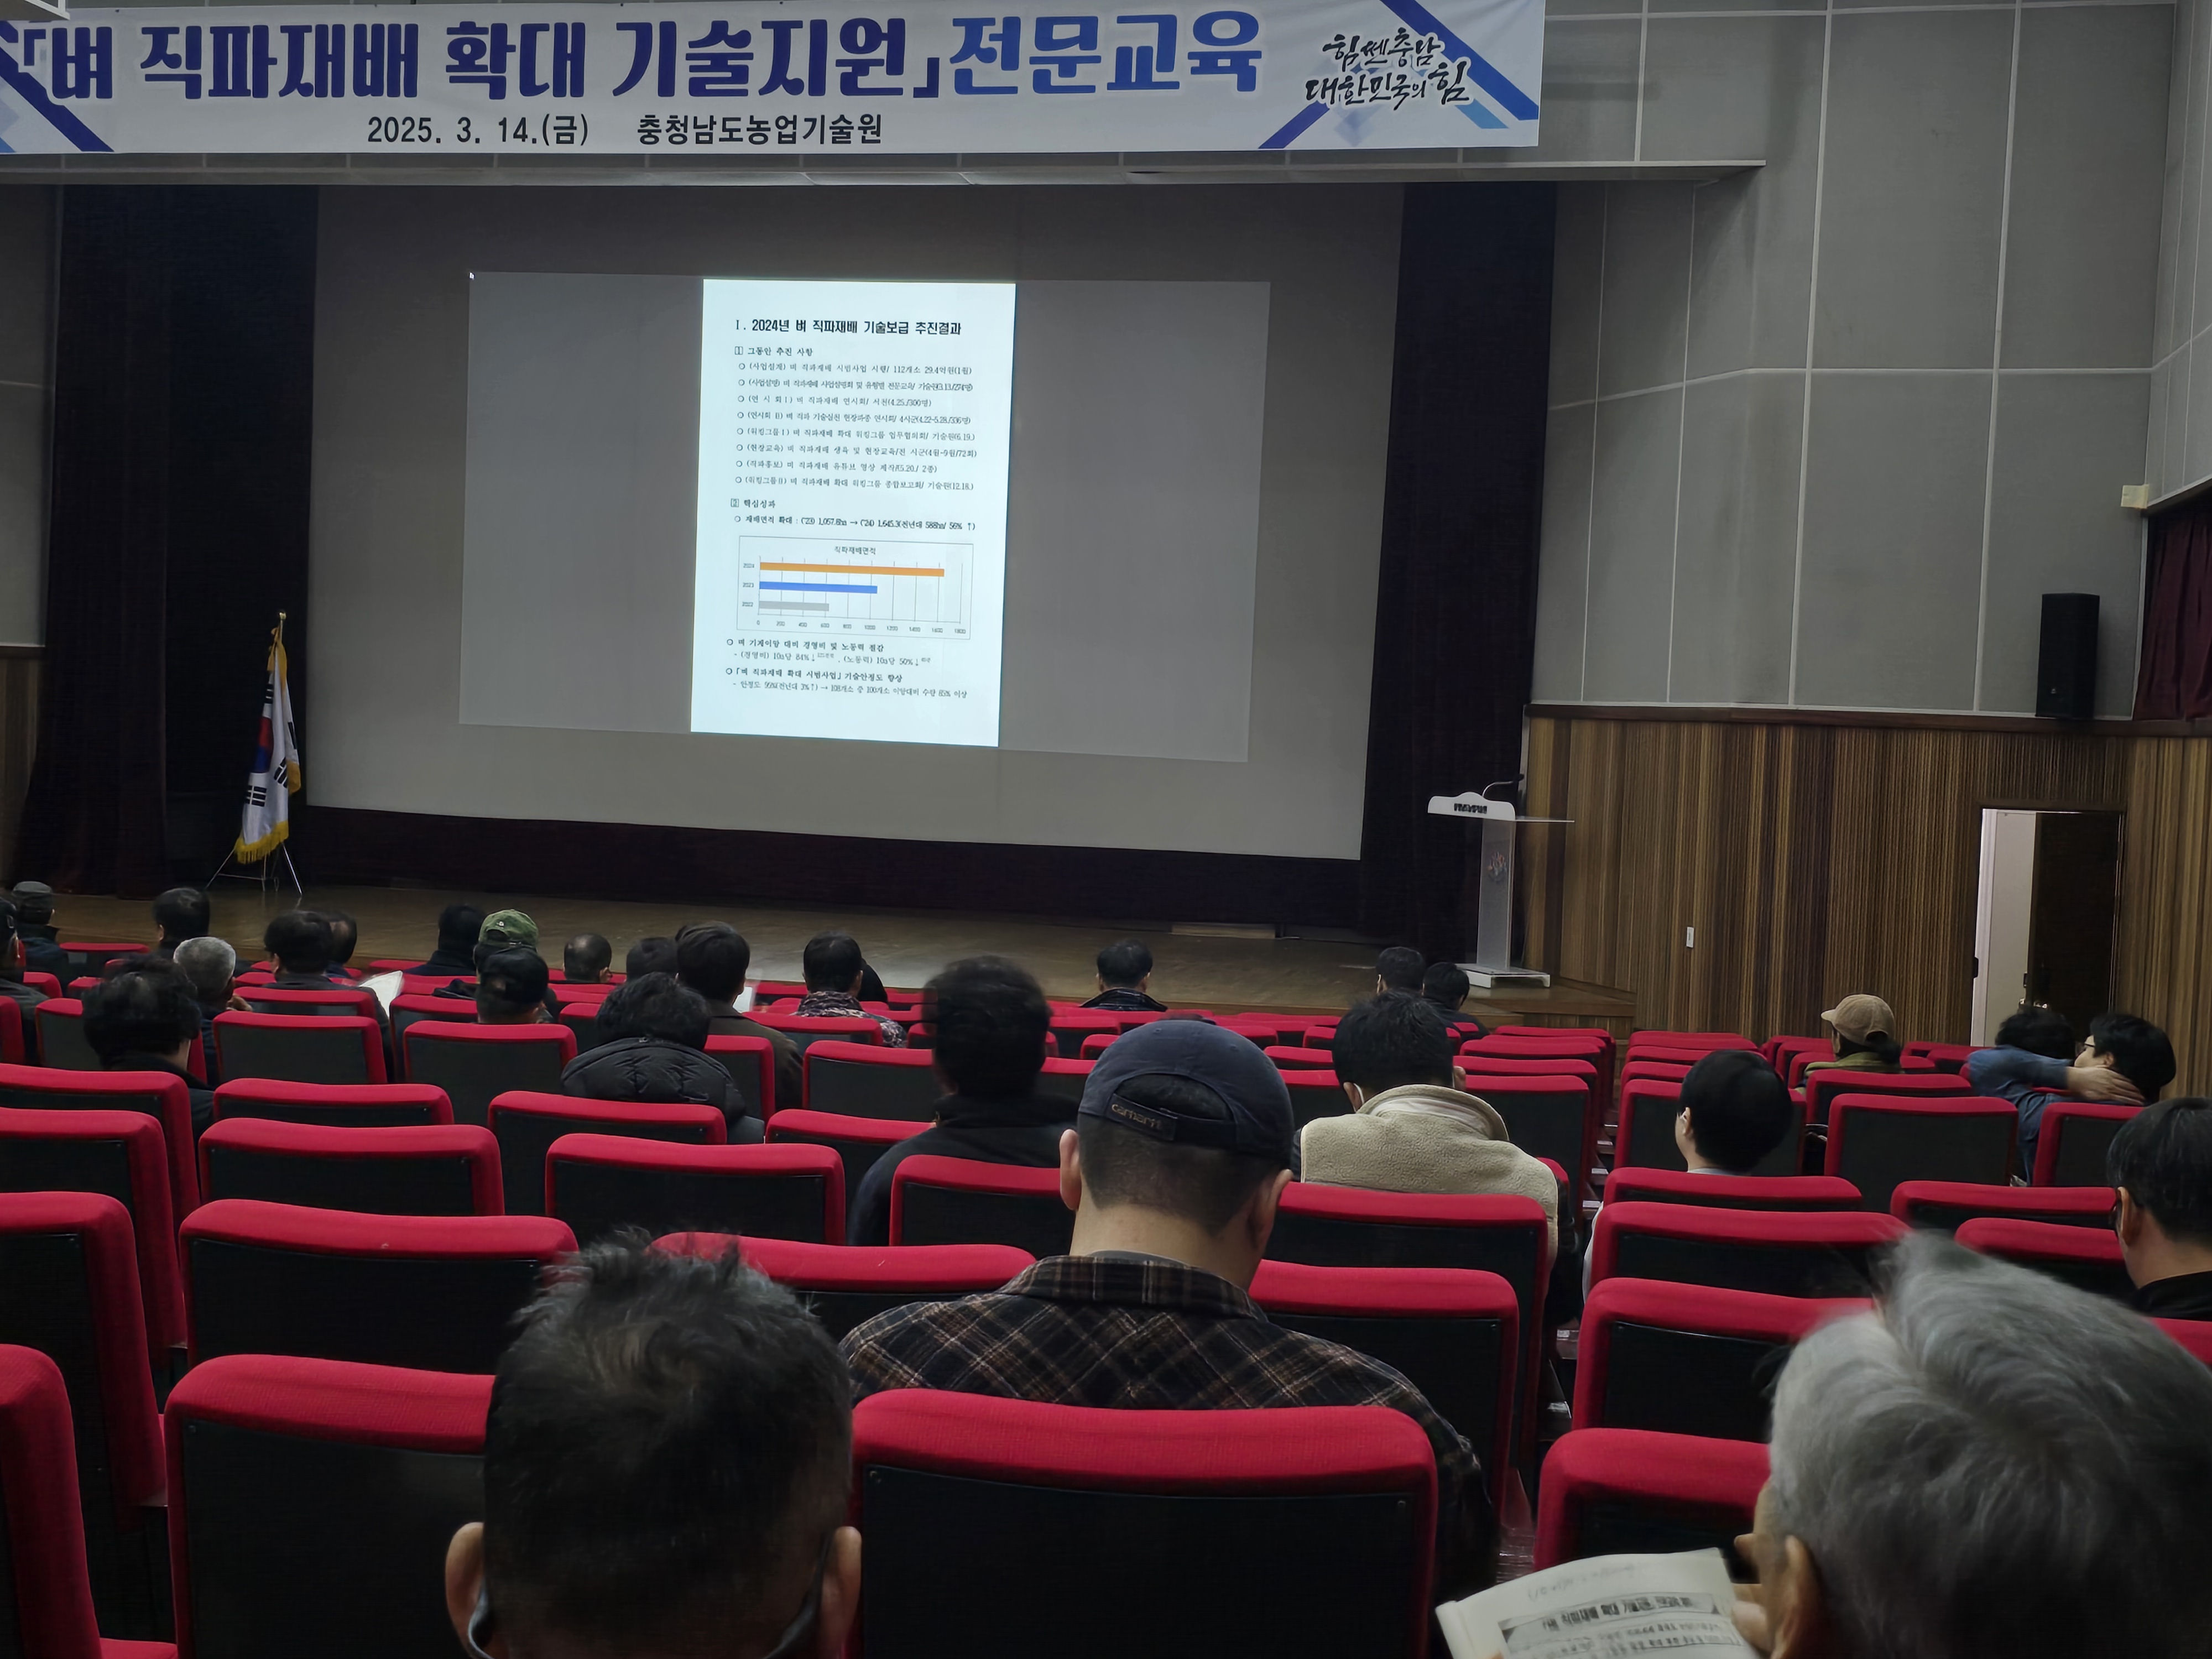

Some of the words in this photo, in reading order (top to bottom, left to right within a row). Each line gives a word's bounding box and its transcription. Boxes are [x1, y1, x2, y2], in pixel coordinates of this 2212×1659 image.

[140, 23, 418, 99] 직파재배
[446, 21, 585, 100] 확대
[1428, 61, 1470, 105] 힘
[368, 117, 442, 144] 2025.
[457, 117, 481, 144] 3.
[498, 114, 589, 145] 14.(금)
[637, 113, 882, 145] 충청남도농업기술원
[752, 319, 789, 332] 2024년
[813, 320, 857, 333] 직파재배
[864, 321, 909, 334] 기술보급
[915, 322, 961, 335] 추진결과
[776, 347, 791, 356] 추진
